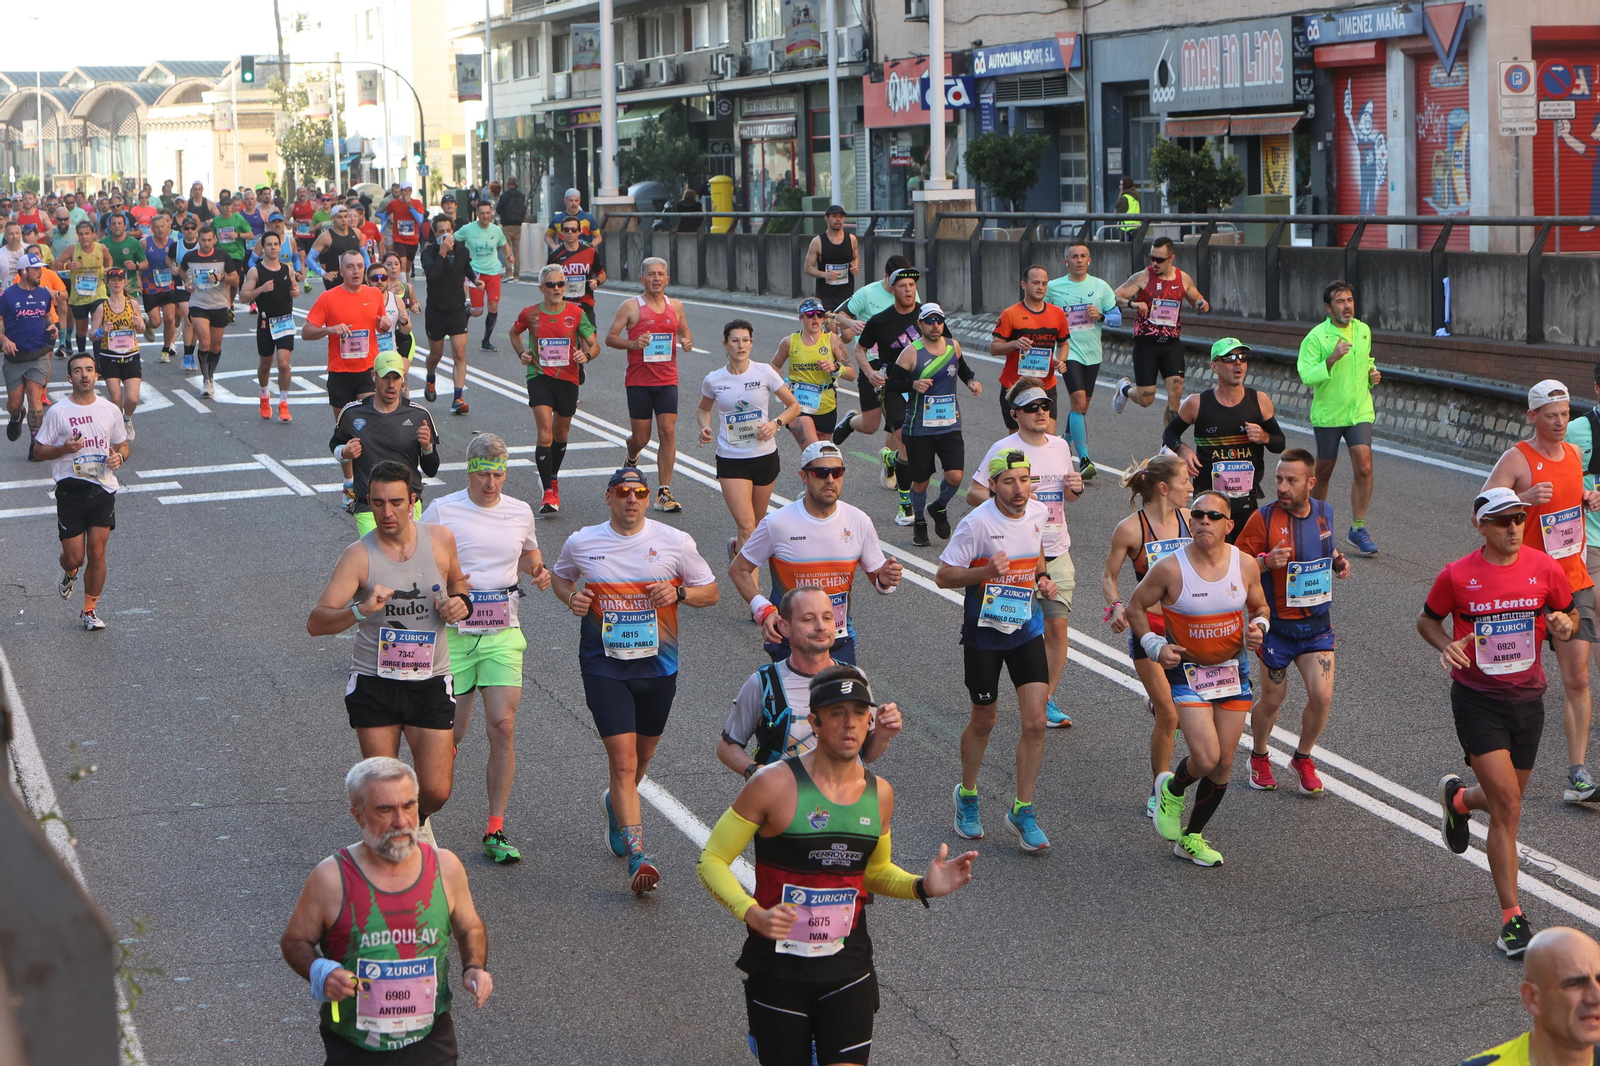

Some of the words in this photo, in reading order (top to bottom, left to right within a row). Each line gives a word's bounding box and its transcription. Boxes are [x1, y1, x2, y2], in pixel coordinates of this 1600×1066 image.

[1337, 13, 1373, 36] JIMENEZ
[988, 50, 1023, 69] AUTOCLIMA
[1023, 48, 1044, 66] SPORT,
[1044, 47, 1056, 62] S.L.
[800, 384, 819, 393] ZURICH
[936, 396, 953, 404] ZURICH
[69, 415, 93, 427] Run
[738, 413, 758, 421] ZURICH
[72, 428, 78, 437] &
[1211, 447, 1253, 460] ALOHA
[1558, 511, 1579, 522] ZURICH
[1563, 538, 1574, 546] JOHN
[1304, 579, 1319, 587] 6044
[1003, 589, 1027, 598] ZURICH
[1302, 588, 1322, 597] JURADO
[478, 594, 504, 602] ZURICH
[385, 601, 429, 617] Rudo.
[1000, 604, 1016, 613] 6093
[1469, 602, 1492, 613] Los
[1494, 597, 1539, 609] Lentos
[621, 613, 650, 622] ZURICH
[984, 612, 1008, 622] MANOLO
[1501, 611, 1536, 620] ATLETISMO
[465, 619, 504, 627] MARIS/LATVIA
[1496, 622, 1527, 633] ZURICH
[399, 633, 429, 642] ZURICH
[621, 631, 639, 639] 4815
[634, 640, 654, 648] PABLO
[1497, 641, 1516, 651] 6920
[398, 650, 416, 659] 7342
[1493, 652, 1521, 662] ALBERTO
[381, 659, 401, 668] JORGE
[401, 661, 431, 669] BRIONGOS
[1215, 677, 1236, 687] JIMENEZ
[811, 893, 846, 904] ZURICH
[808, 916, 831, 927] 6875
[360, 928, 439, 948] ABDOULAY
[809, 932, 829, 941] IVAN
[386, 964, 426, 977] ZURICH
[385, 990, 411, 1001] 6980
[379, 1005, 416, 1016] ANTONIO
